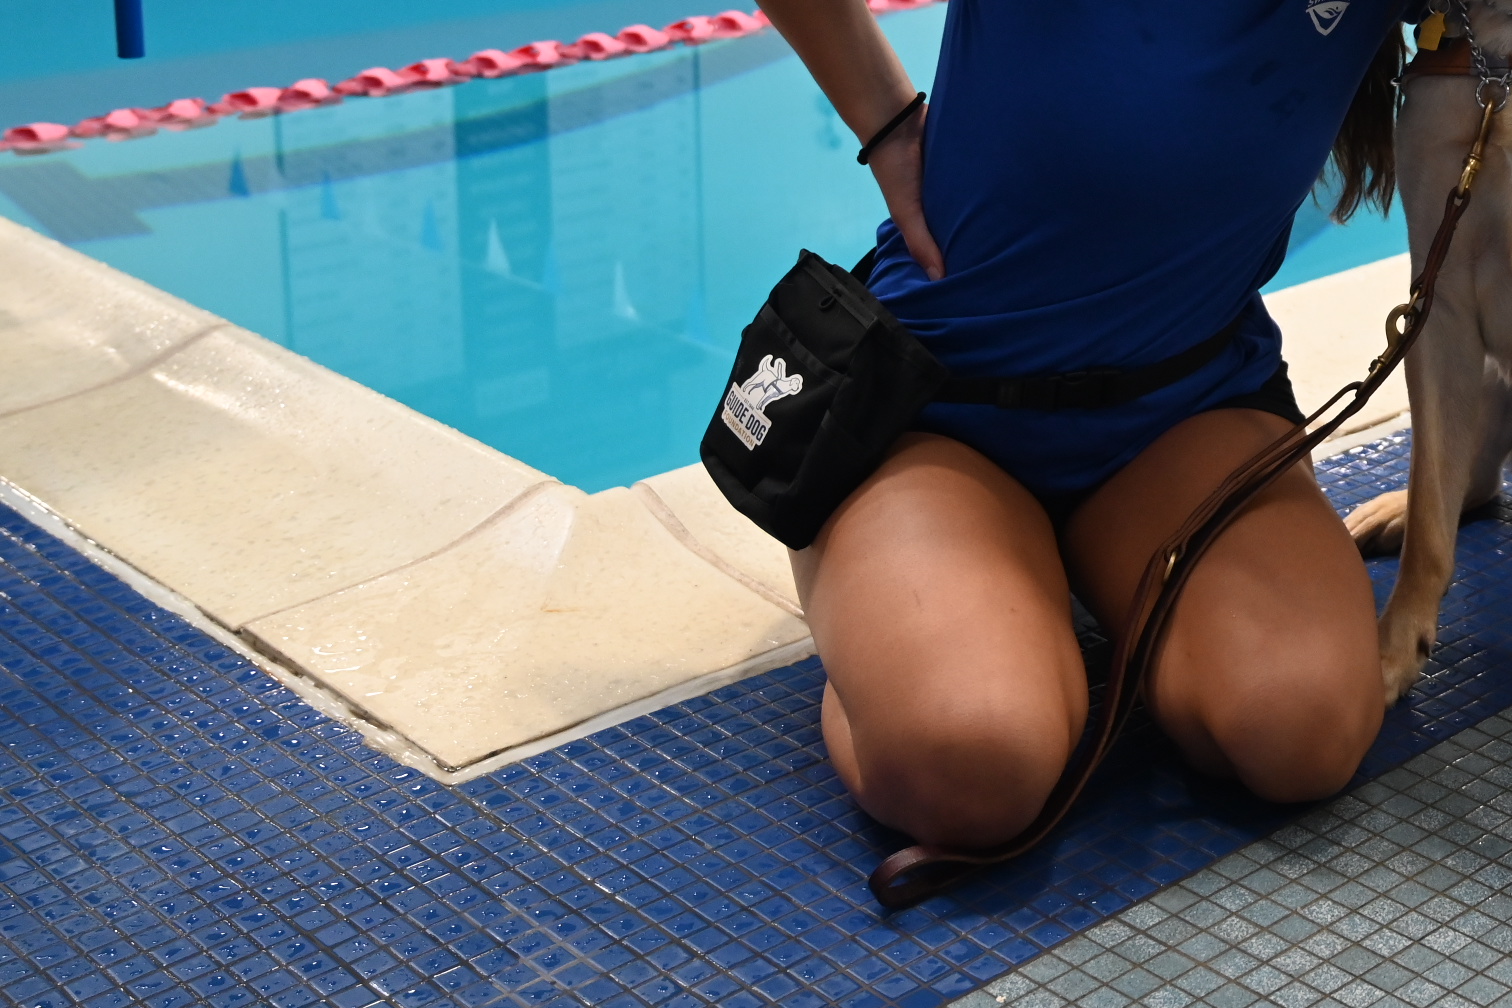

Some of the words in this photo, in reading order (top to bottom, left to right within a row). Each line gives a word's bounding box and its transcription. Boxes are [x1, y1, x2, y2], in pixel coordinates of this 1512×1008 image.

[724, 409, 756, 447] FOUNDATION
[726, 390, 750, 424] GUIDE
[745, 413, 767, 442] DOG
